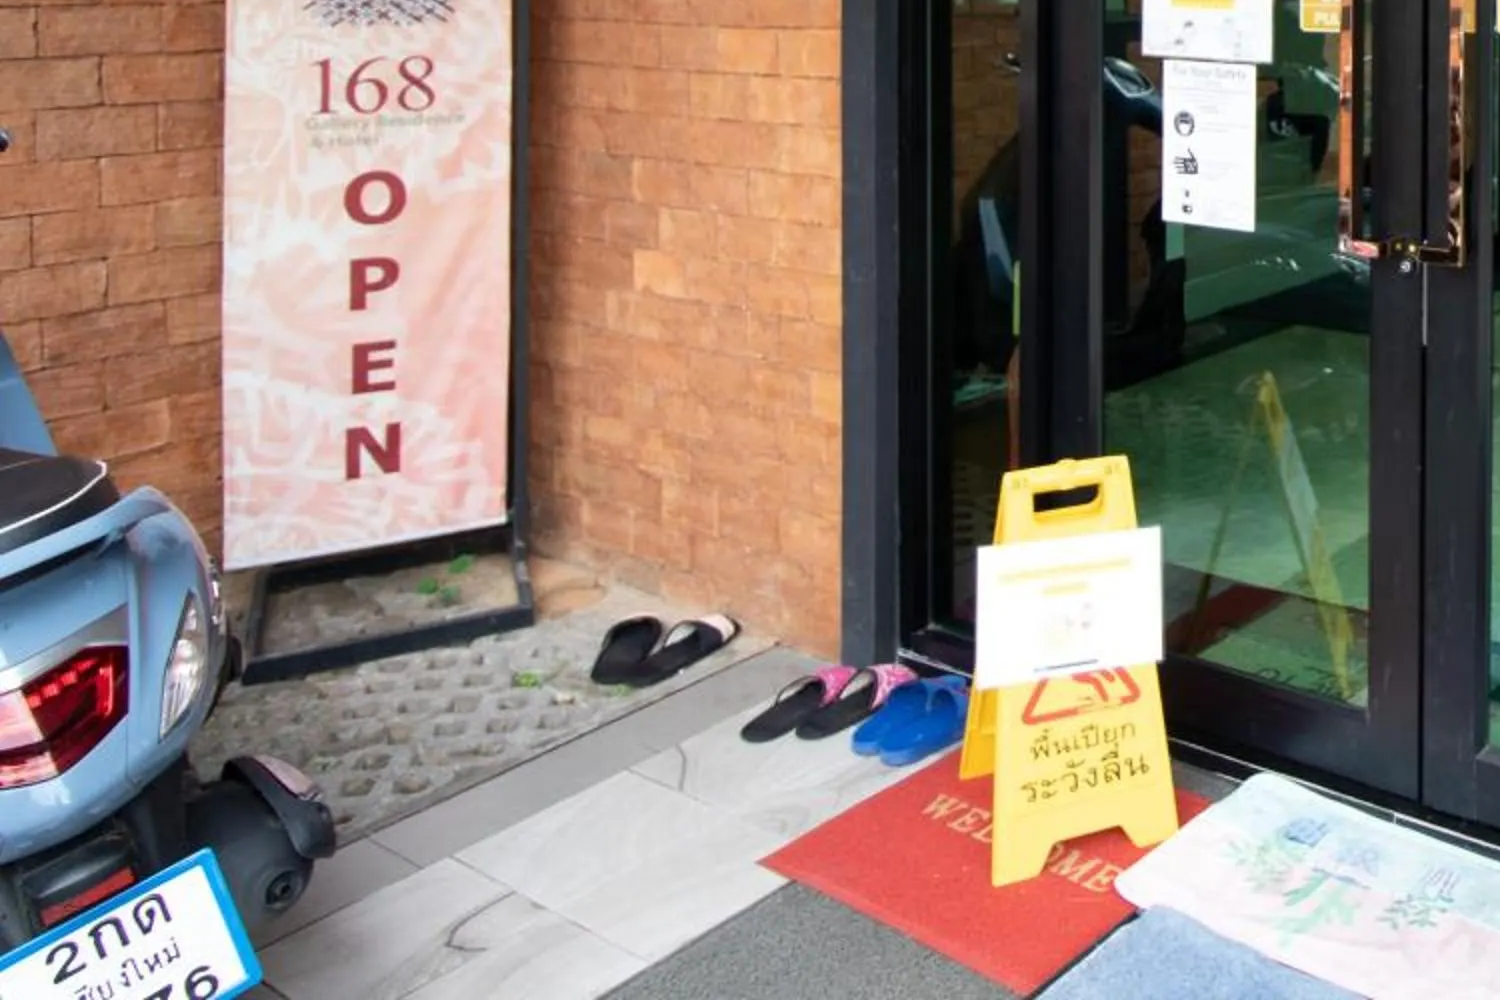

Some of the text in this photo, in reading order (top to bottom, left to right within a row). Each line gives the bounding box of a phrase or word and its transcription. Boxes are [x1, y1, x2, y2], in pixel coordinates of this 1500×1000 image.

[309, 54, 436, 115] 168
[343, 170, 407, 481] OPEN
[920, 793, 1124, 893] WELME
[45, 893, 172, 985] 2กด
